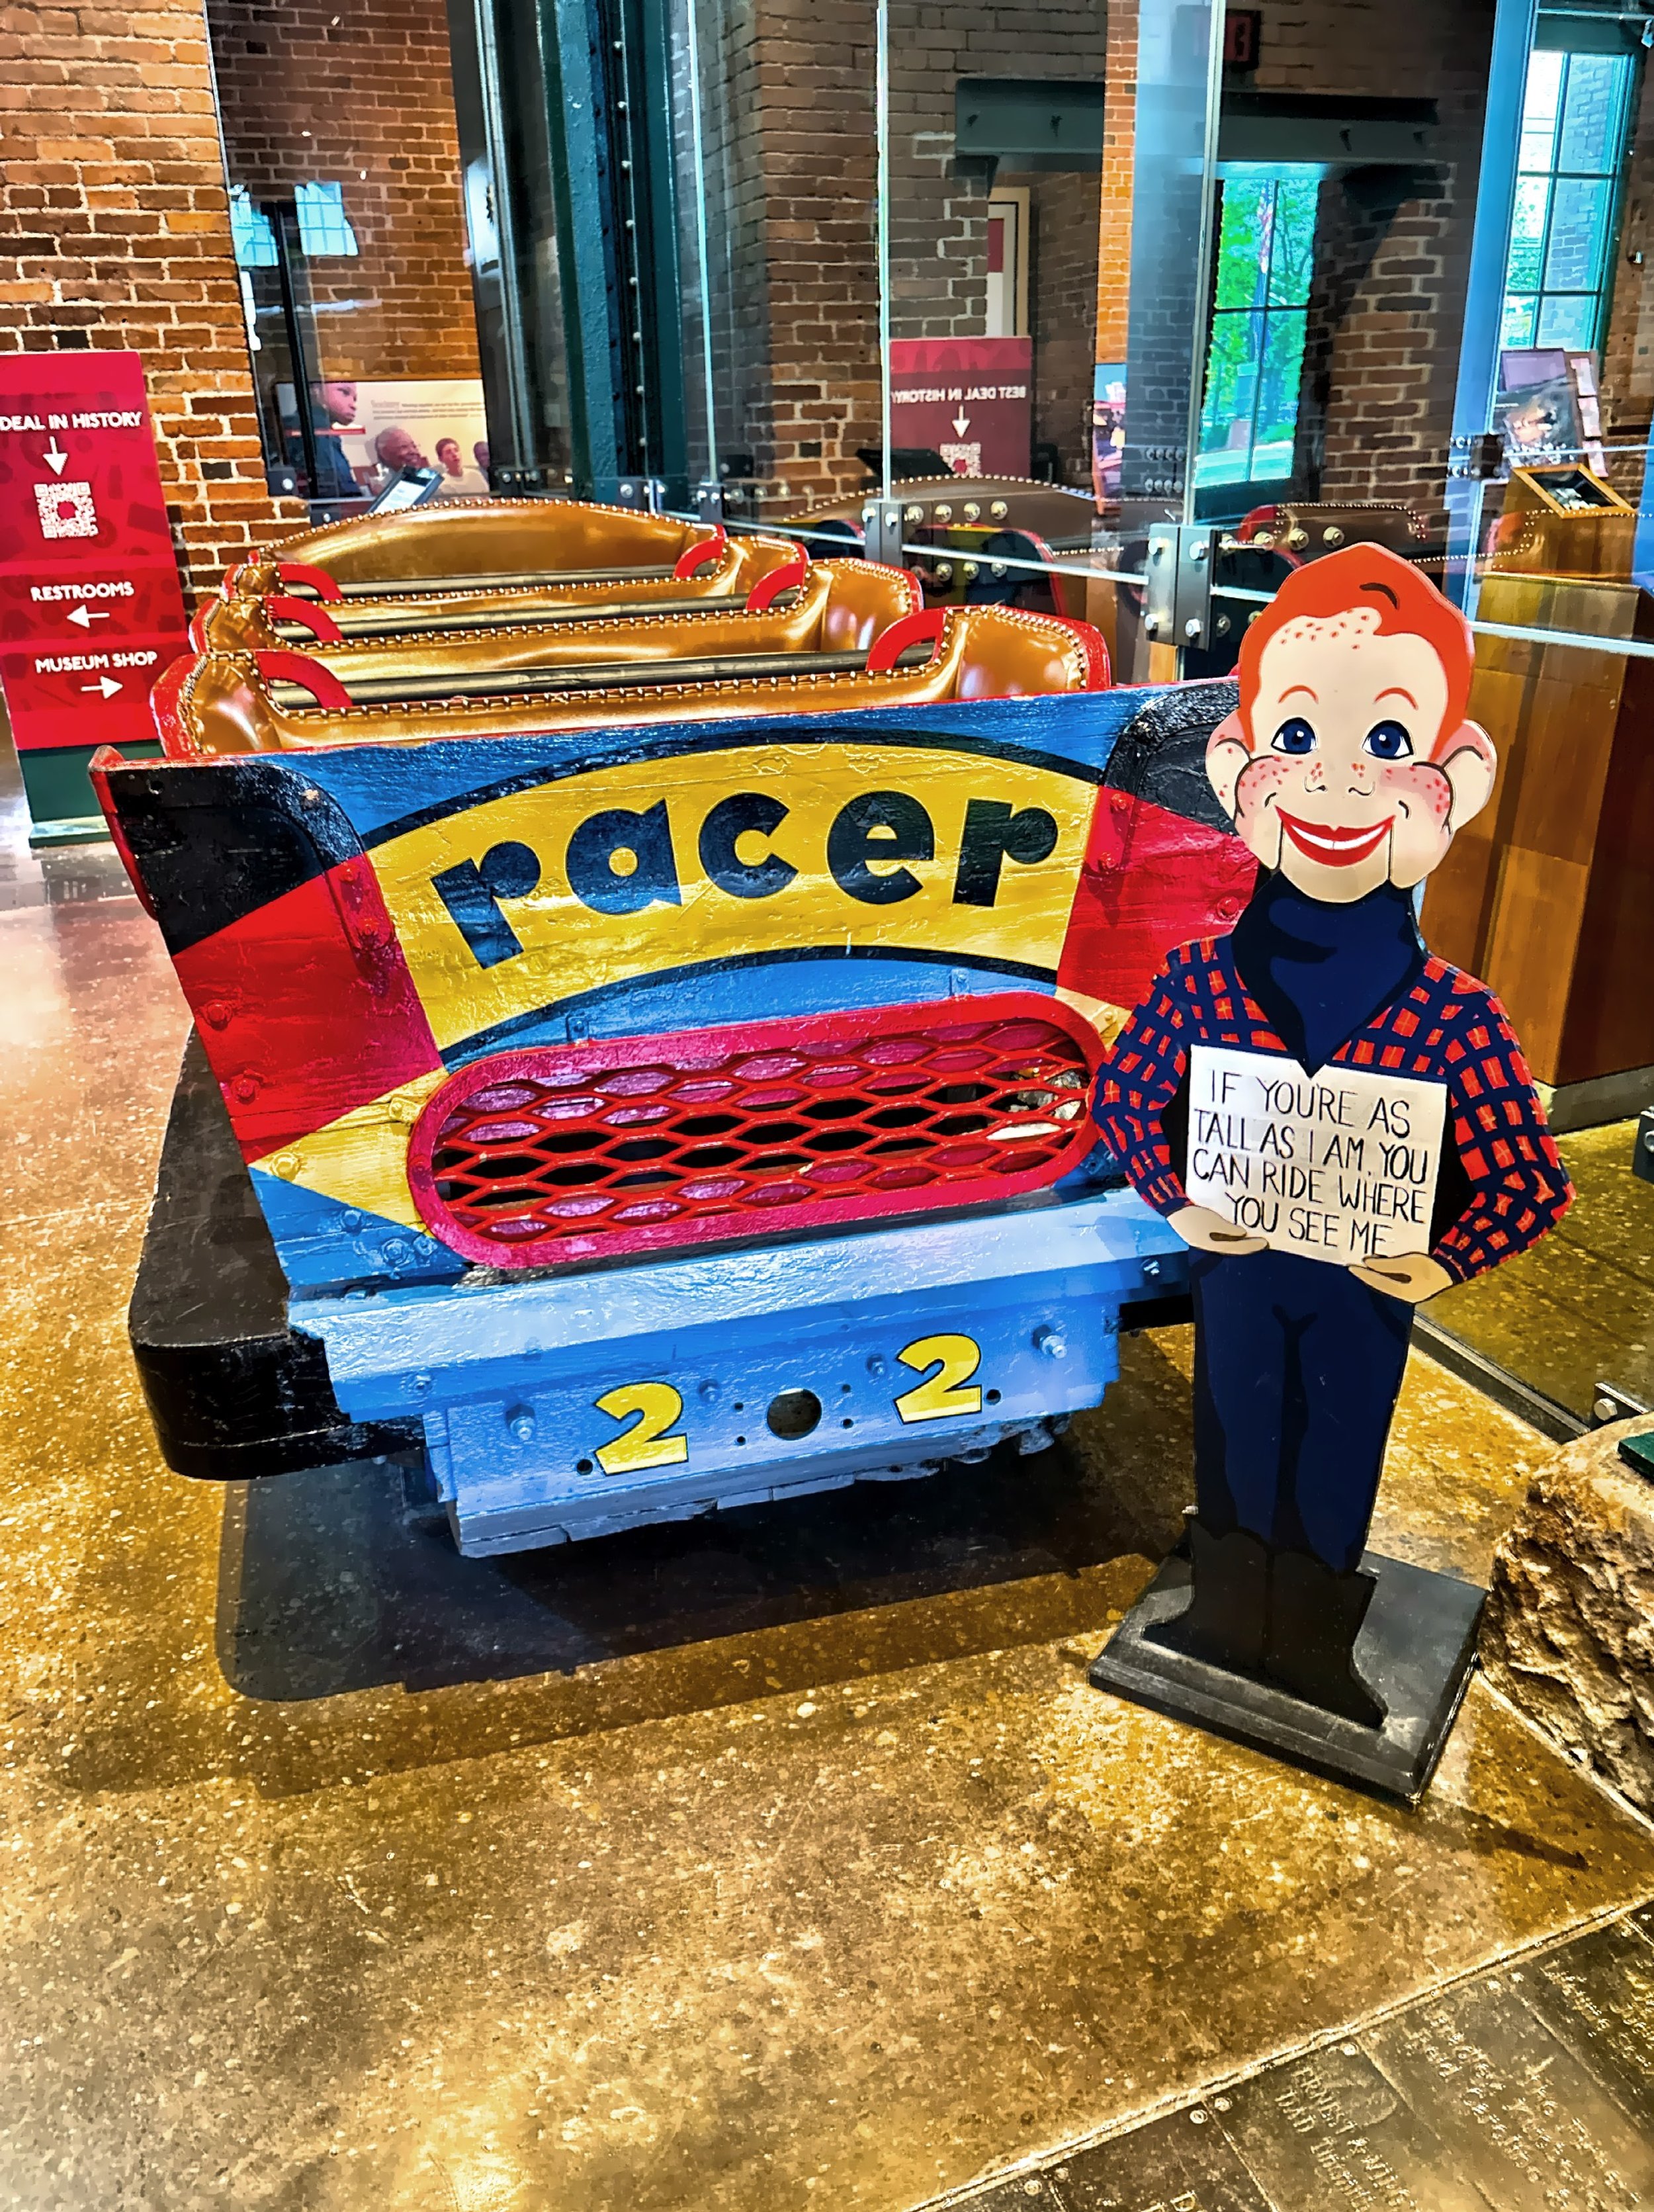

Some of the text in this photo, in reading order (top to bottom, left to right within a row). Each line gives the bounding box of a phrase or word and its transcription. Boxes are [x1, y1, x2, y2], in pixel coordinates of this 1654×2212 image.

[0, 411, 143, 431] DEAL IN HISTORY
[30, 582, 135, 602] RESTROOMS
[35, 651, 158, 674] MUSEUM SHOP
[430, 790, 1059, 969] racer
[1211, 1069, 1242, 1104] IF
[1367, 1096, 1411, 1139] AS
[1194, 1108, 1252, 1151] TALL
[1259, 1122, 1295, 1160] AS
[1309, 1129, 1315, 1163] I
[1379, 1141, 1428, 1185] YOU
[1193, 1148, 1428, 1224] CAN RIDE WHERE
[1225, 1192, 1393, 1257] YOU SEE ME
[594, 1333, 982, 1476] 2 2
